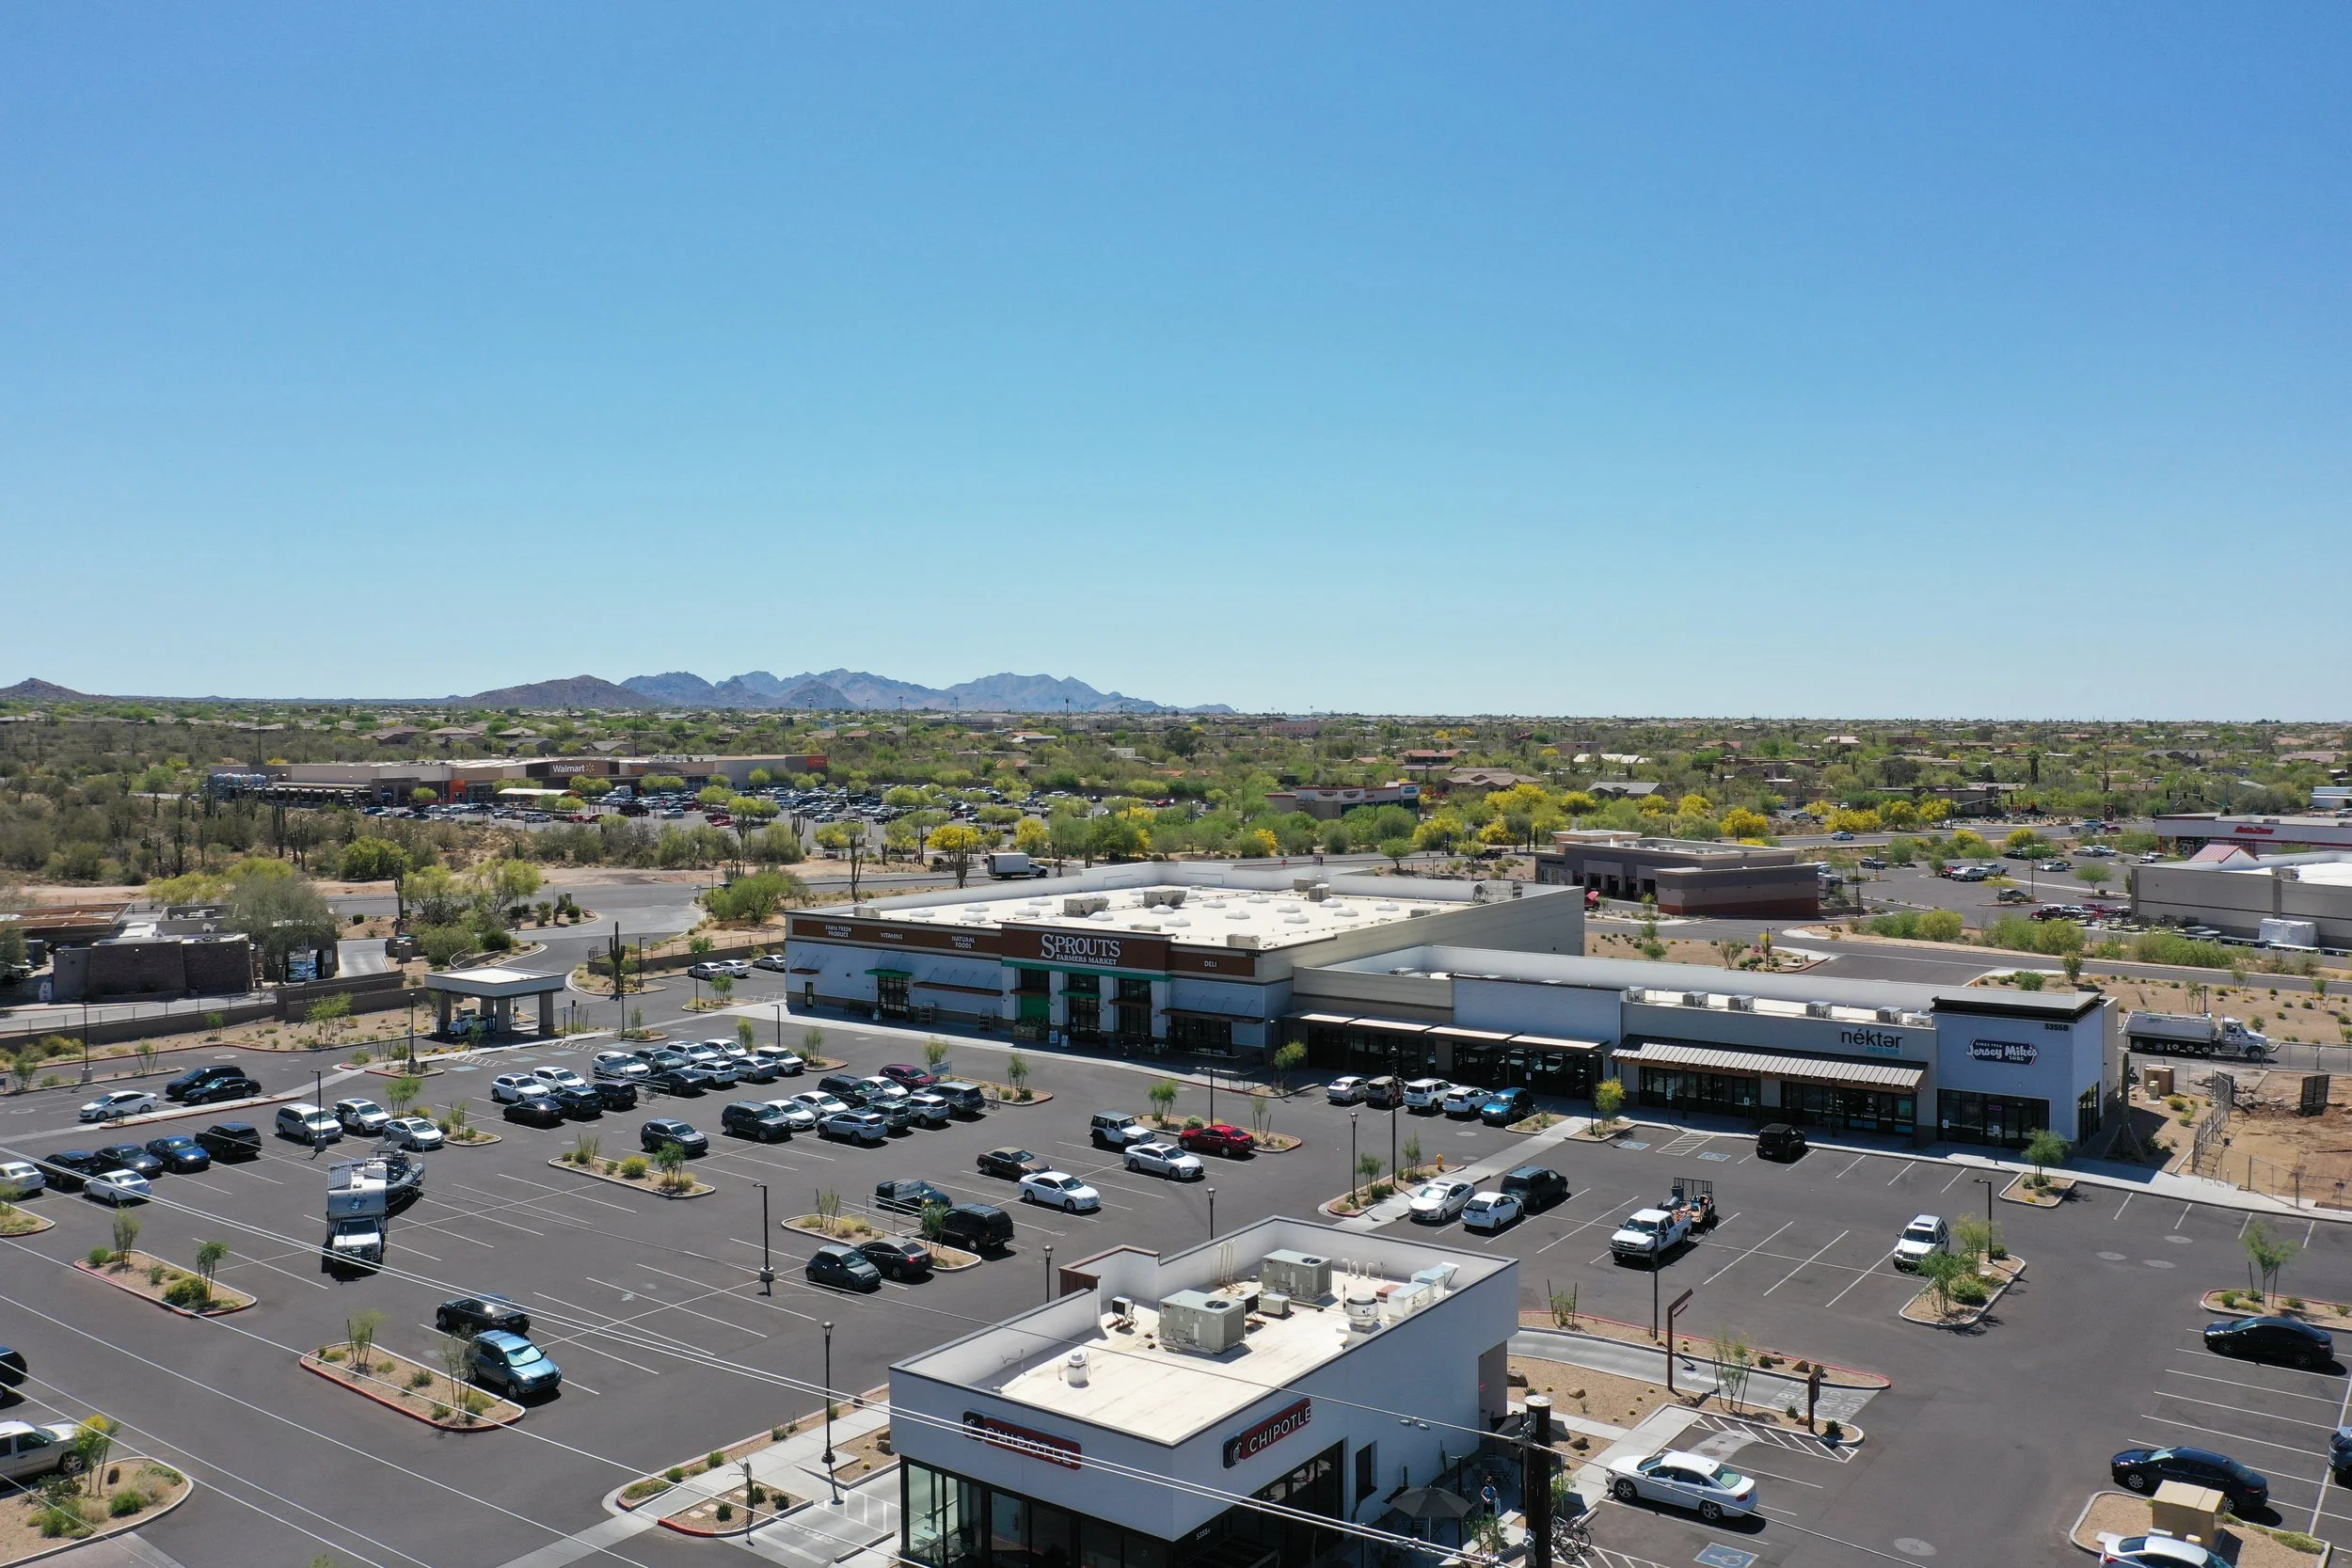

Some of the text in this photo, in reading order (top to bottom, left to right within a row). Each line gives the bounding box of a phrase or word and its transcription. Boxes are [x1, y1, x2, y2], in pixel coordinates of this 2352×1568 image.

[552, 764, 585, 772] Walmart
[951, 935, 976, 943] NATURAL
[1041, 933, 1121, 958] SPROUTS
[1057, 954, 1118, 966] FARMERS MARKET
[2044, 1022, 2069, 1032] 5355B
[1966, 1044, 2038, 1059] Jersey Mike's
[1249, 1406, 1311, 1452] CHIPOTLE
[985, 1428, 1072, 1465] CHIPOTLE
